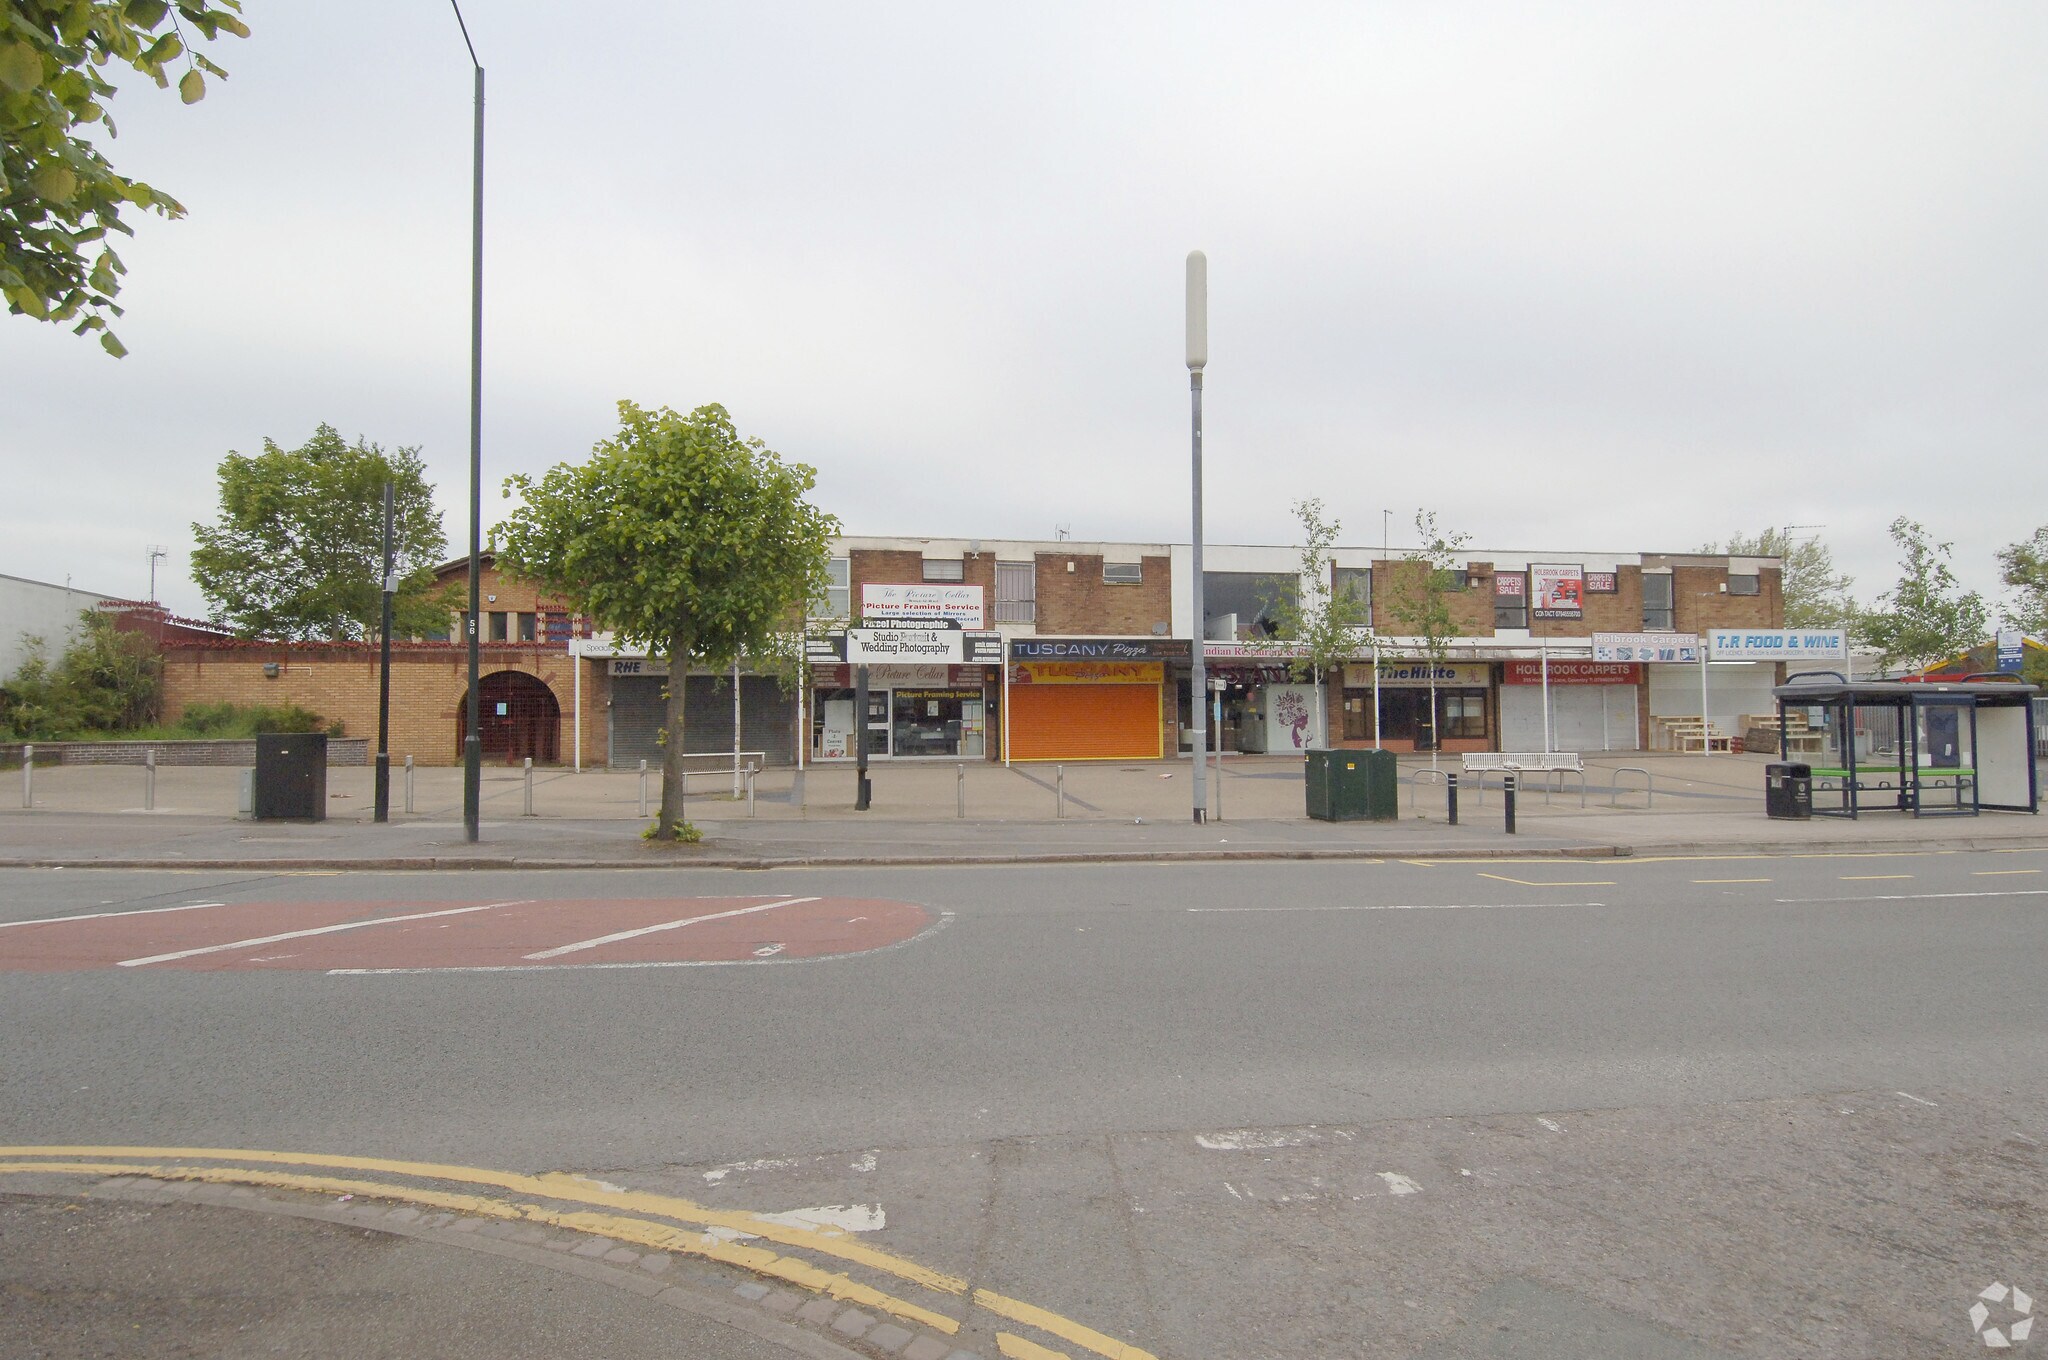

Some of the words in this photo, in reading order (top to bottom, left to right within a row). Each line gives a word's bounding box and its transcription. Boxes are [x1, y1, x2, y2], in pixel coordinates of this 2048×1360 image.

[1559, 569, 1579, 577] CARPETS
[1588, 574, 1612, 582] CARPETS
[1497, 577, 1521, 586] CARPETS
[1590, 581, 1611, 590] SALE
[883, 587, 897, 598] The
[905, 590, 937, 599] Picture
[944, 590, 970, 599] Cellar
[1499, 586, 1520, 595] SALE
[904, 603, 941, 611] Framing
[891, 619, 949, 629] Photographic
[873, 632, 899, 642] Studio
[931, 632, 937, 642] &
[1595, 634, 1647, 643] Holbrook
[1651, 636, 1696, 645] Carpets
[1745, 636, 1783, 648] FOOD
[1788, 636, 1799, 648] &
[1804, 636, 1840, 648] WINE
[861, 643, 898, 655] Wedding
[899, 643, 950, 655] Photography
[1014, 643, 1109, 656] TUSCANY
[1112, 643, 1148, 657] Pizza
[1202, 647, 1231, 656] ndian
[1287, 647, 1295, 656] &
[614, 662, 641, 673] RHE
[875, 664, 912, 681] Picture
[914, 664, 945, 681] Cellar
[1580, 665, 1630, 675] CARPETS
[1380, 667, 1409, 679] The
[1467, 668, 1481, 683] 光
